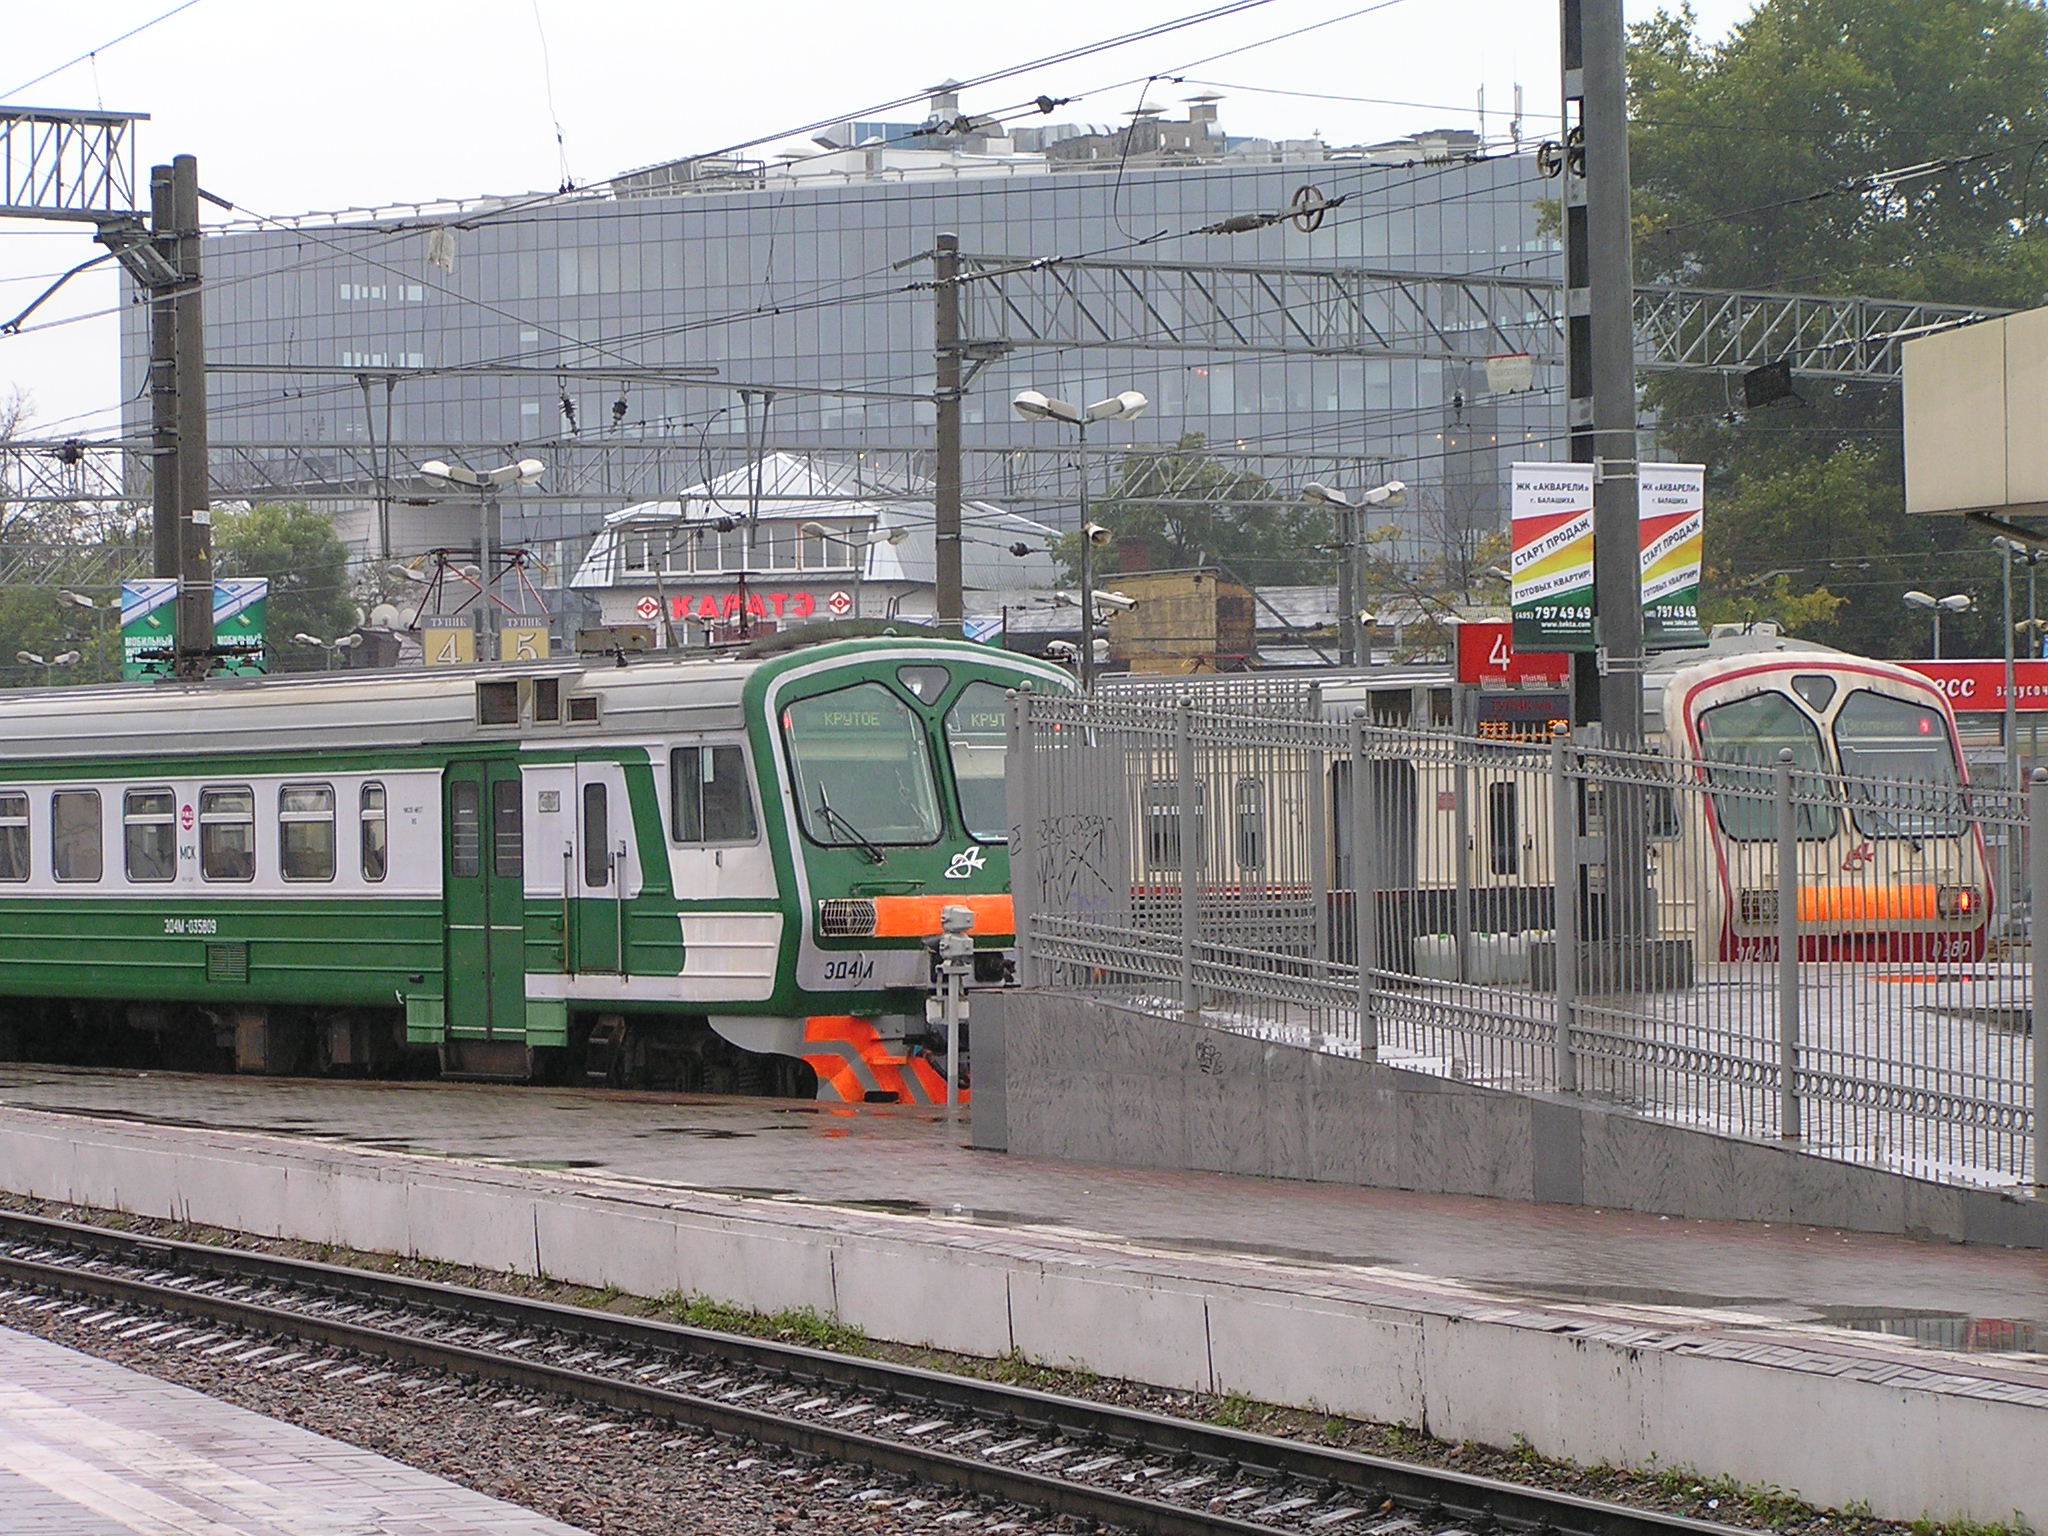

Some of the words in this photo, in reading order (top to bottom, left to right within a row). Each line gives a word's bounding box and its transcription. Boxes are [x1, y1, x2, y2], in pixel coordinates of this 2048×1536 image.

[1516, 483, 1531, 491] ЖК
[1533, 482, 1590, 492] «АКВАРЕЛИ»
[1515, 543, 1544, 566] СТАРТ
[1546, 519, 1590, 549] ПРОДАЖ
[1642, 543, 1662, 566] СТАРТ
[1663, 519, 1700, 549] ПРОДАЖ
[1515, 581, 1552, 599] ГОТОВЫХ
[1553, 569, 1592, 587] КВАРТИР!
[672, 592, 816, 619] КАРАТЭ
[1535, 606, 1558, 619] 797
[1559, 606, 1575, 619] 49
[1576, 606, 1592, 619] 49
[1656, 605, 1673, 618] 797
[1673, 605, 1684, 618] 49
[1685, 605, 1697, 618] 49
[430, 617, 467, 627] ТУПИК
[507, 617, 542, 627] ТУПИК
[124, 634, 174, 647] МОБИЛЬНЫЙ
[437, 632, 462, 664] 4
[517, 632, 538, 660] 5
[1488, 633, 1511, 672] 4
[824, 712, 880, 726] КРУТОЕ
[824, 960, 874, 980] ЭД4М
